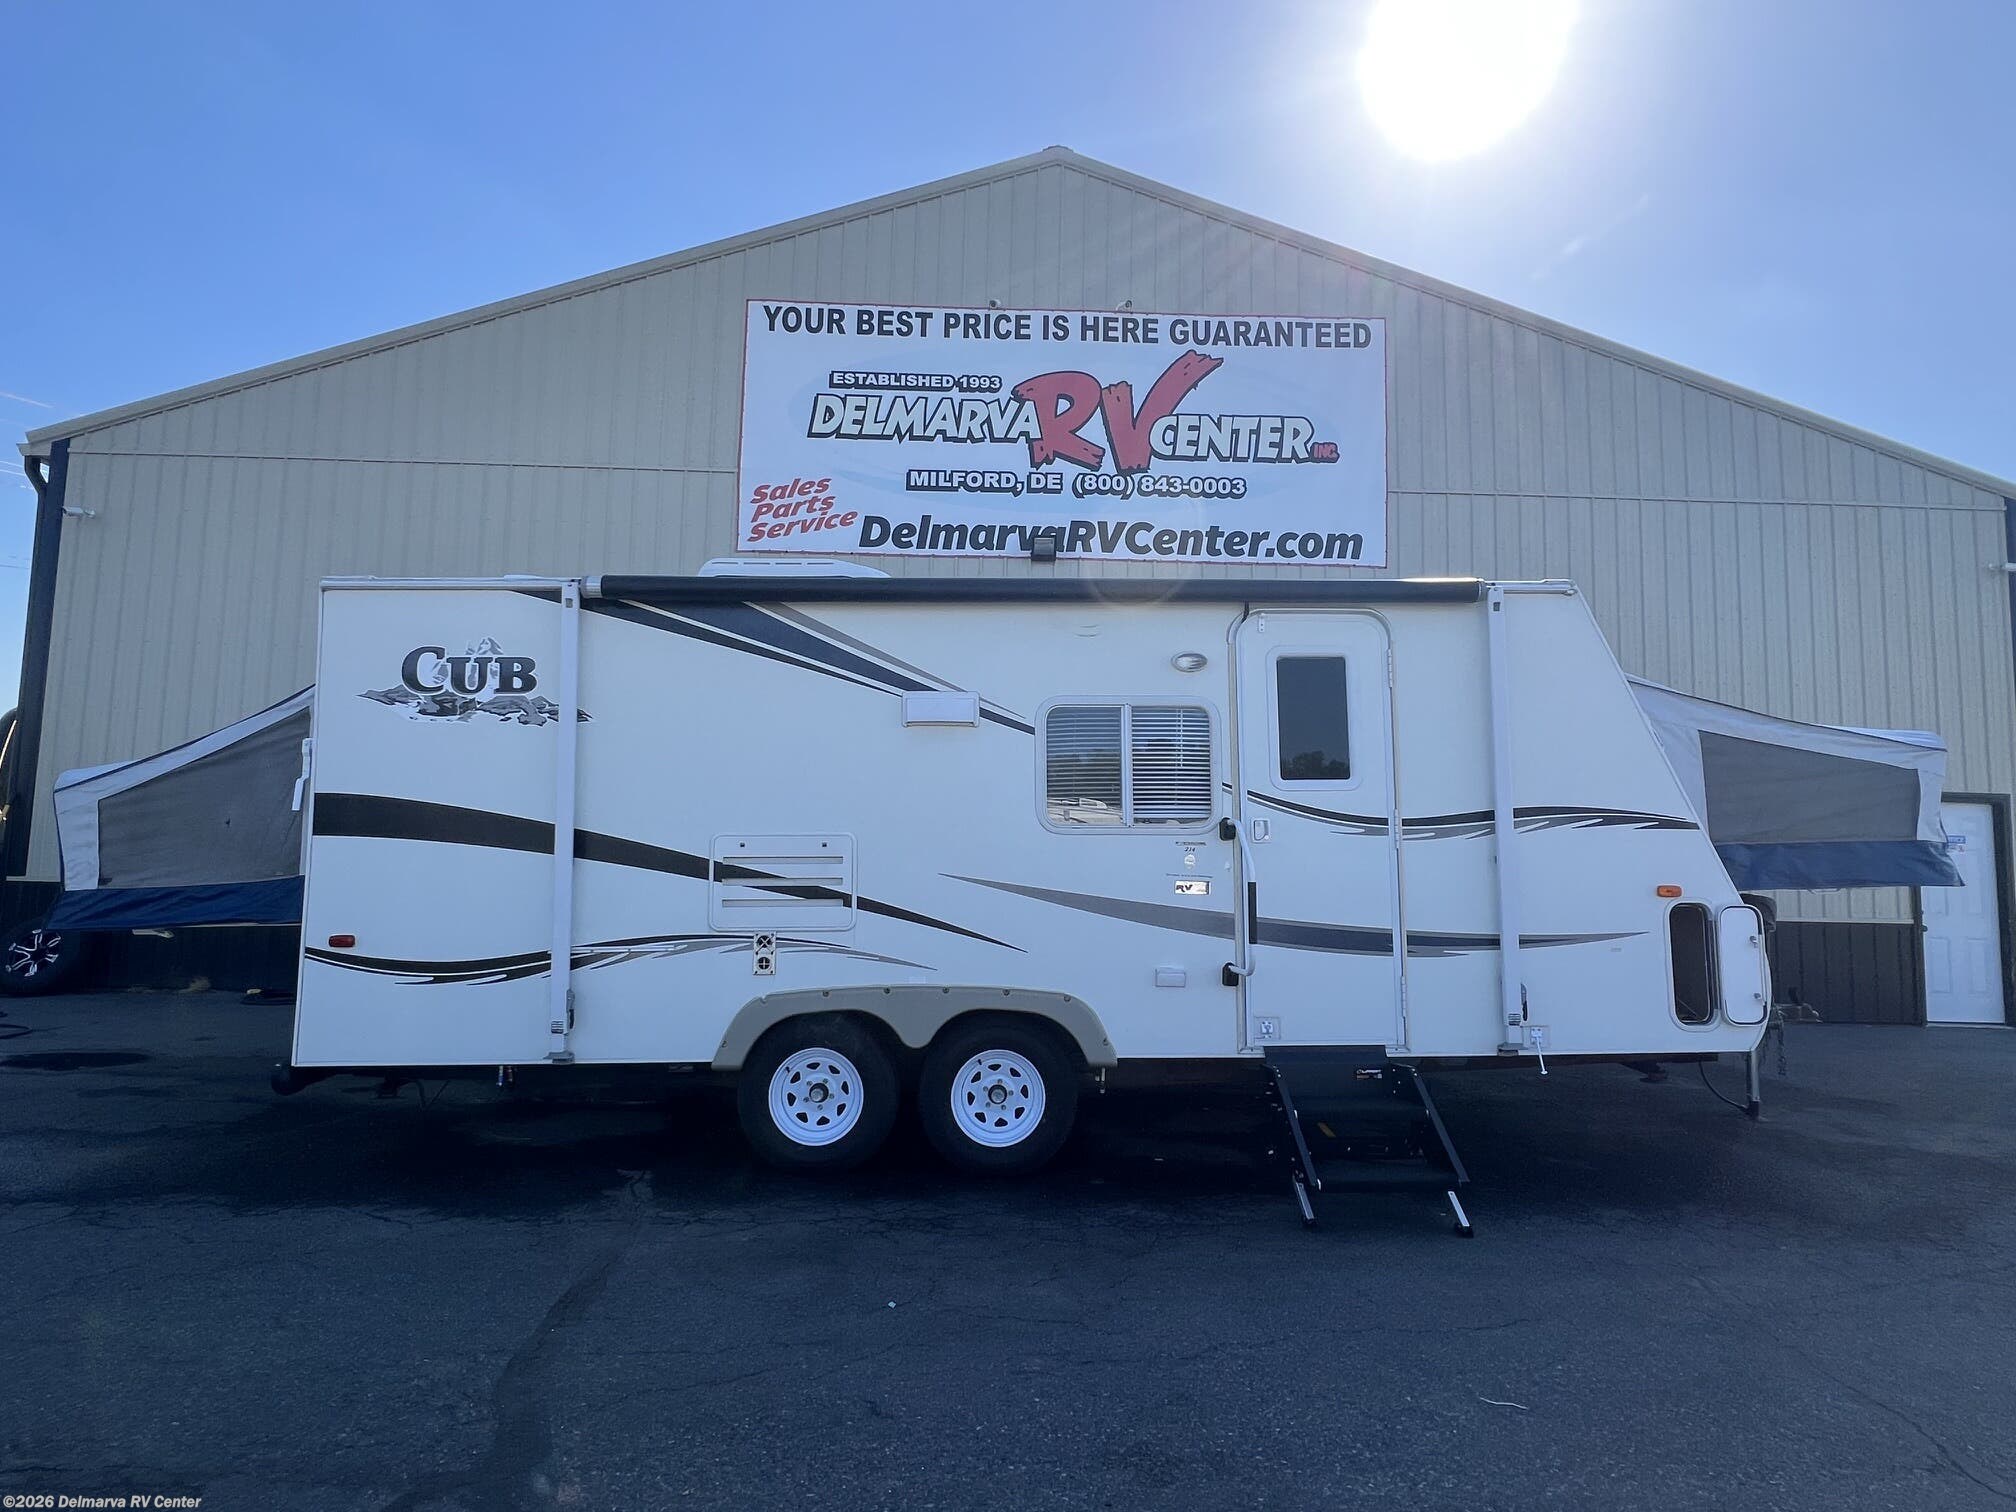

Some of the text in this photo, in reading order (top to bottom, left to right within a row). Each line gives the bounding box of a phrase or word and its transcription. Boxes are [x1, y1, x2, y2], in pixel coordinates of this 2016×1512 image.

[763, 305, 1372, 349] YOUR BEST PRICE IS HERE GUARANTEED
[831, 372, 1002, 390] ESTABLISHED 1993
[807, 394, 1043, 443] DELMARVA
[1011, 350, 1223, 473] RV
[1150, 414, 1314, 462] CENTER
[751, 477, 832, 504] Sales
[908, 470, 1247, 497] MILFORD, DE (800) 843-0003
[751, 495, 836, 523] Parts
[747, 511, 859, 543] Service
[859, 515, 1363, 559] DelmarvaRVCenter.com
[401, 646, 538, 695] CUB
